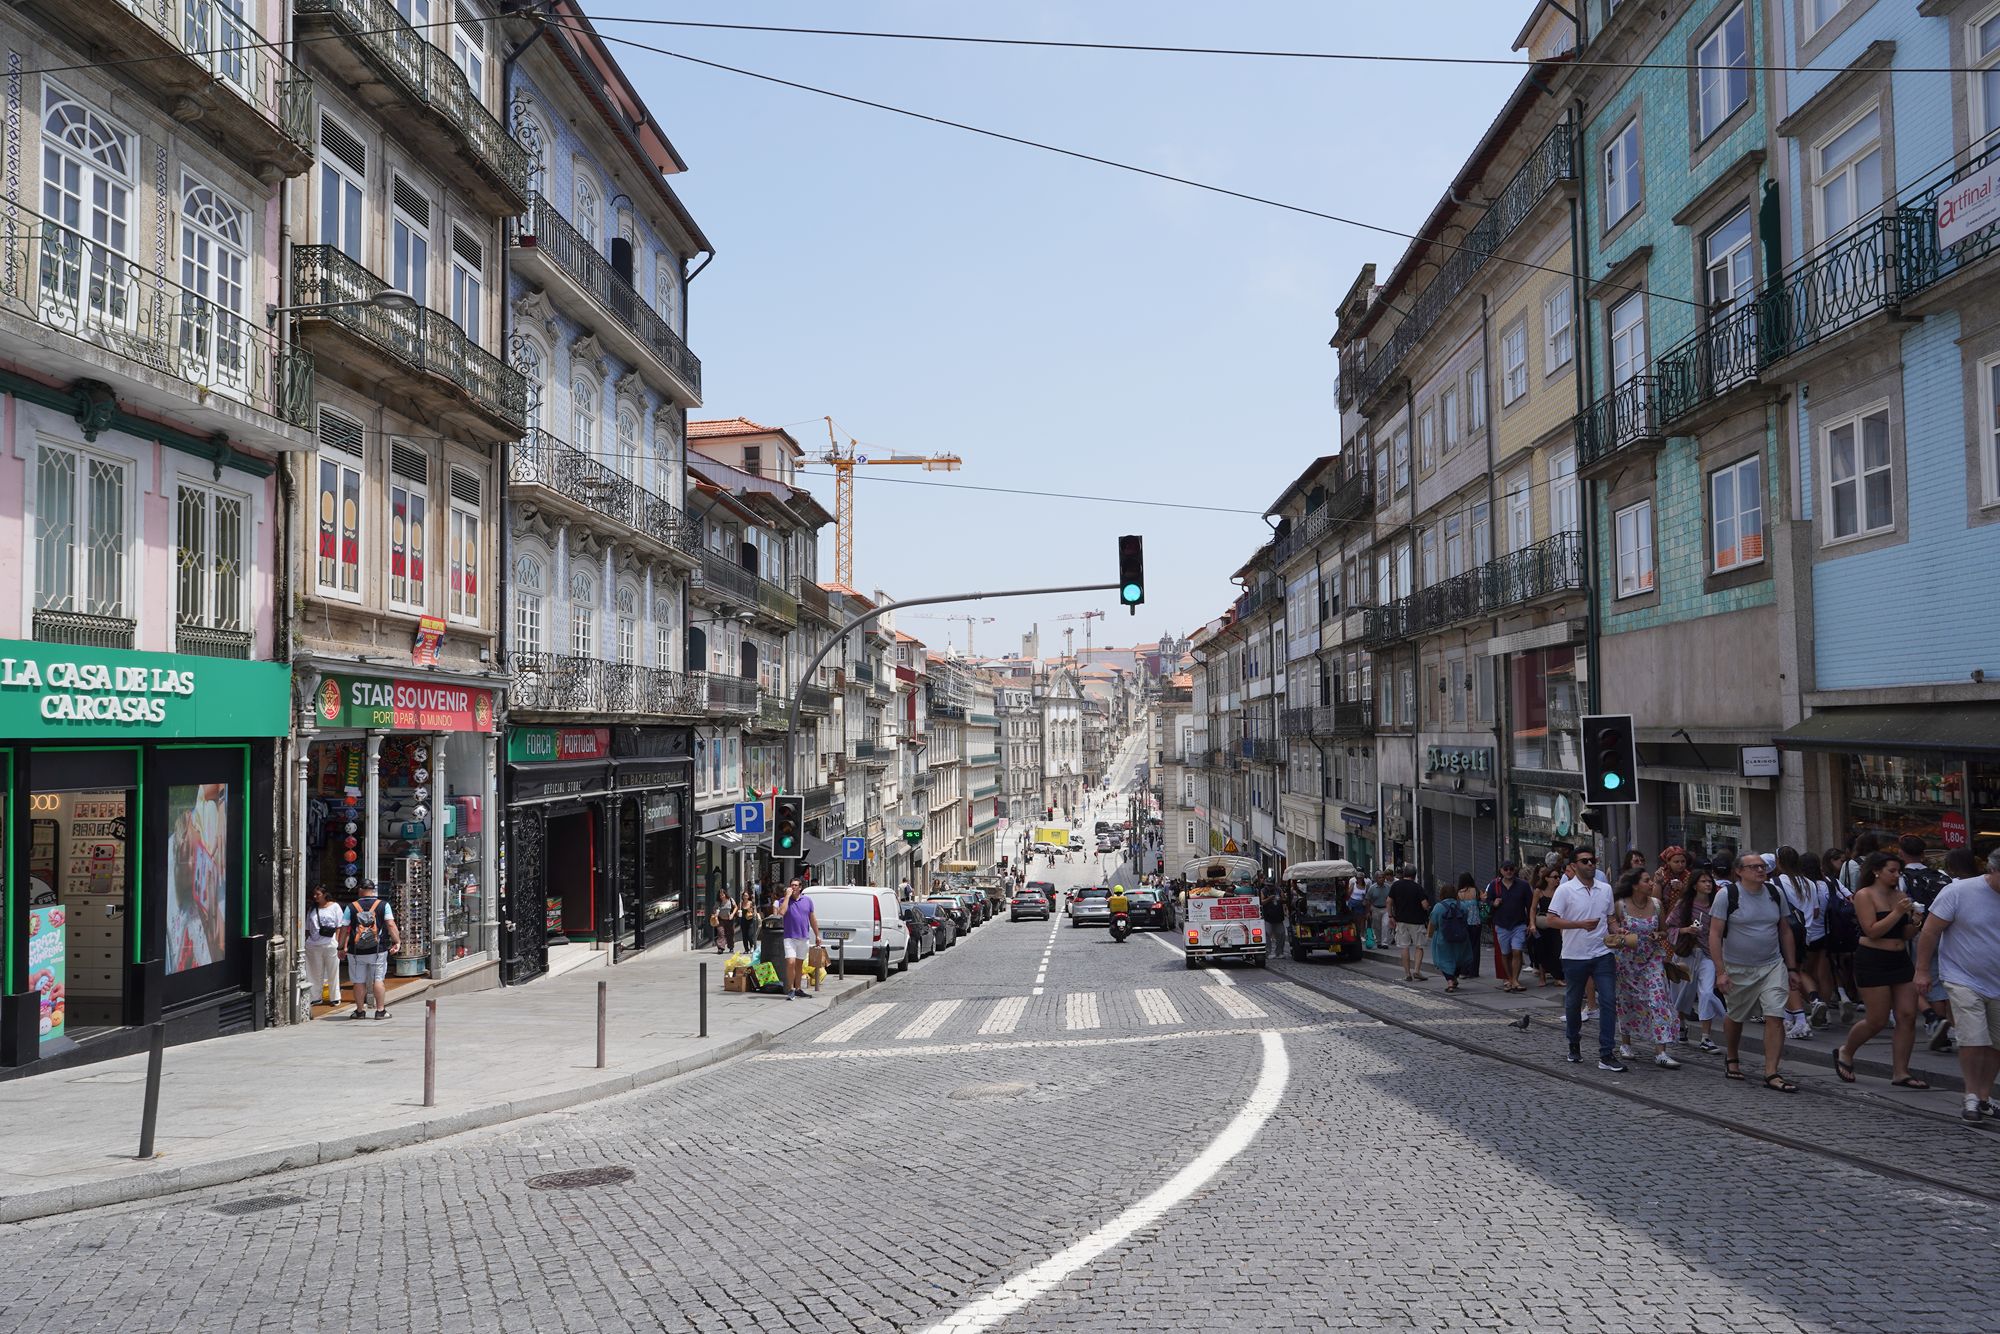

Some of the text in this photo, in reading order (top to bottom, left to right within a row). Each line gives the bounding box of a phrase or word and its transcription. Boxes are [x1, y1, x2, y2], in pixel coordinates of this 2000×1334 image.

[1938, 176, 1991, 229] artfinal
[1, 658, 195, 695] LA CASA DE LAS
[40, 695, 166, 722] CARCASAS
[352, 681, 468, 712] STAR SOUVENIR
[373, 710, 453, 727] PORTO PARA O MUNDO
[526, 734, 597, 756] FORÇA PORTUGAL
[1426, 747, 1489, 773] Angeli
[543, 780, 582, 795] OFFICIAL STORE
[647, 803, 672, 822] sportino
[1942, 821, 1965, 830] BIFANAS
[29, 929, 61, 955] CRAZY
